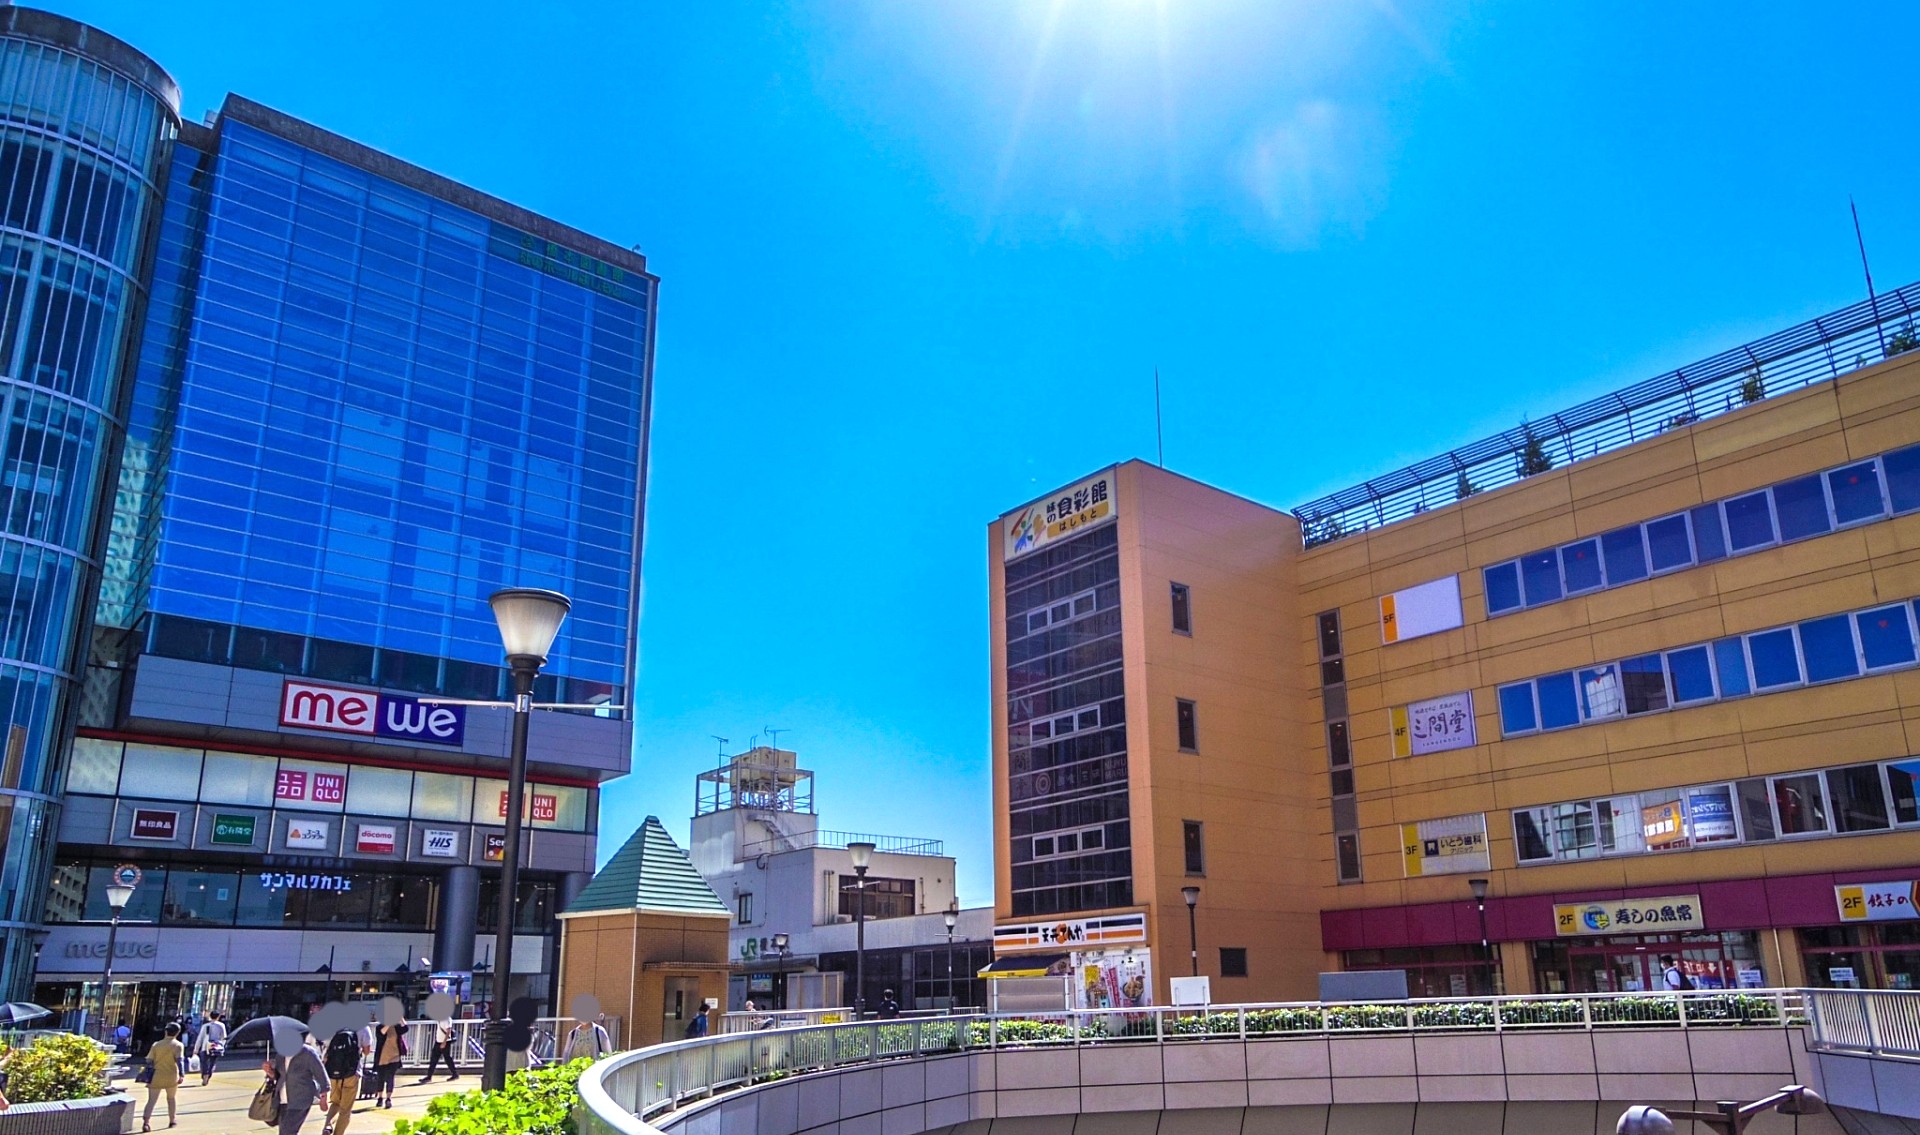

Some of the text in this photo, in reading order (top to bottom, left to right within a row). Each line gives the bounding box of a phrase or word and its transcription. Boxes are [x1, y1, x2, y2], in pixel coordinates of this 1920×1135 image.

[1059, 508, 1097, 532] はしもと
[1383, 612, 1394, 624] 5F
[291, 690, 457, 737] me we
[1413, 709, 1467, 739] 三間堂
[1395, 726, 1406, 737] 4F
[279, 773, 302, 785] ユニ
[317, 776, 339, 788] UNI
[276, 785, 301, 797] クロ
[315, 788, 340, 800] QLO
[534, 797, 552, 808] UNI
[533, 808, 553, 818] QLO
[139, 820, 172, 829] 無印良品
[361, 830, 392, 839] docomo
[489, 837, 505, 846] Ser
[1440, 834, 1482, 848] いとう歯科
[1406, 845, 1417, 855] 3F
[260, 872, 351, 890] サンマルクカフェ
[1843, 896, 1862, 909] 2F
[1867, 893, 1909, 908] 餃子の
[1559, 914, 1574, 926] 2F
[64, 941, 156, 959] me we
[741, 937, 757, 957] JR
